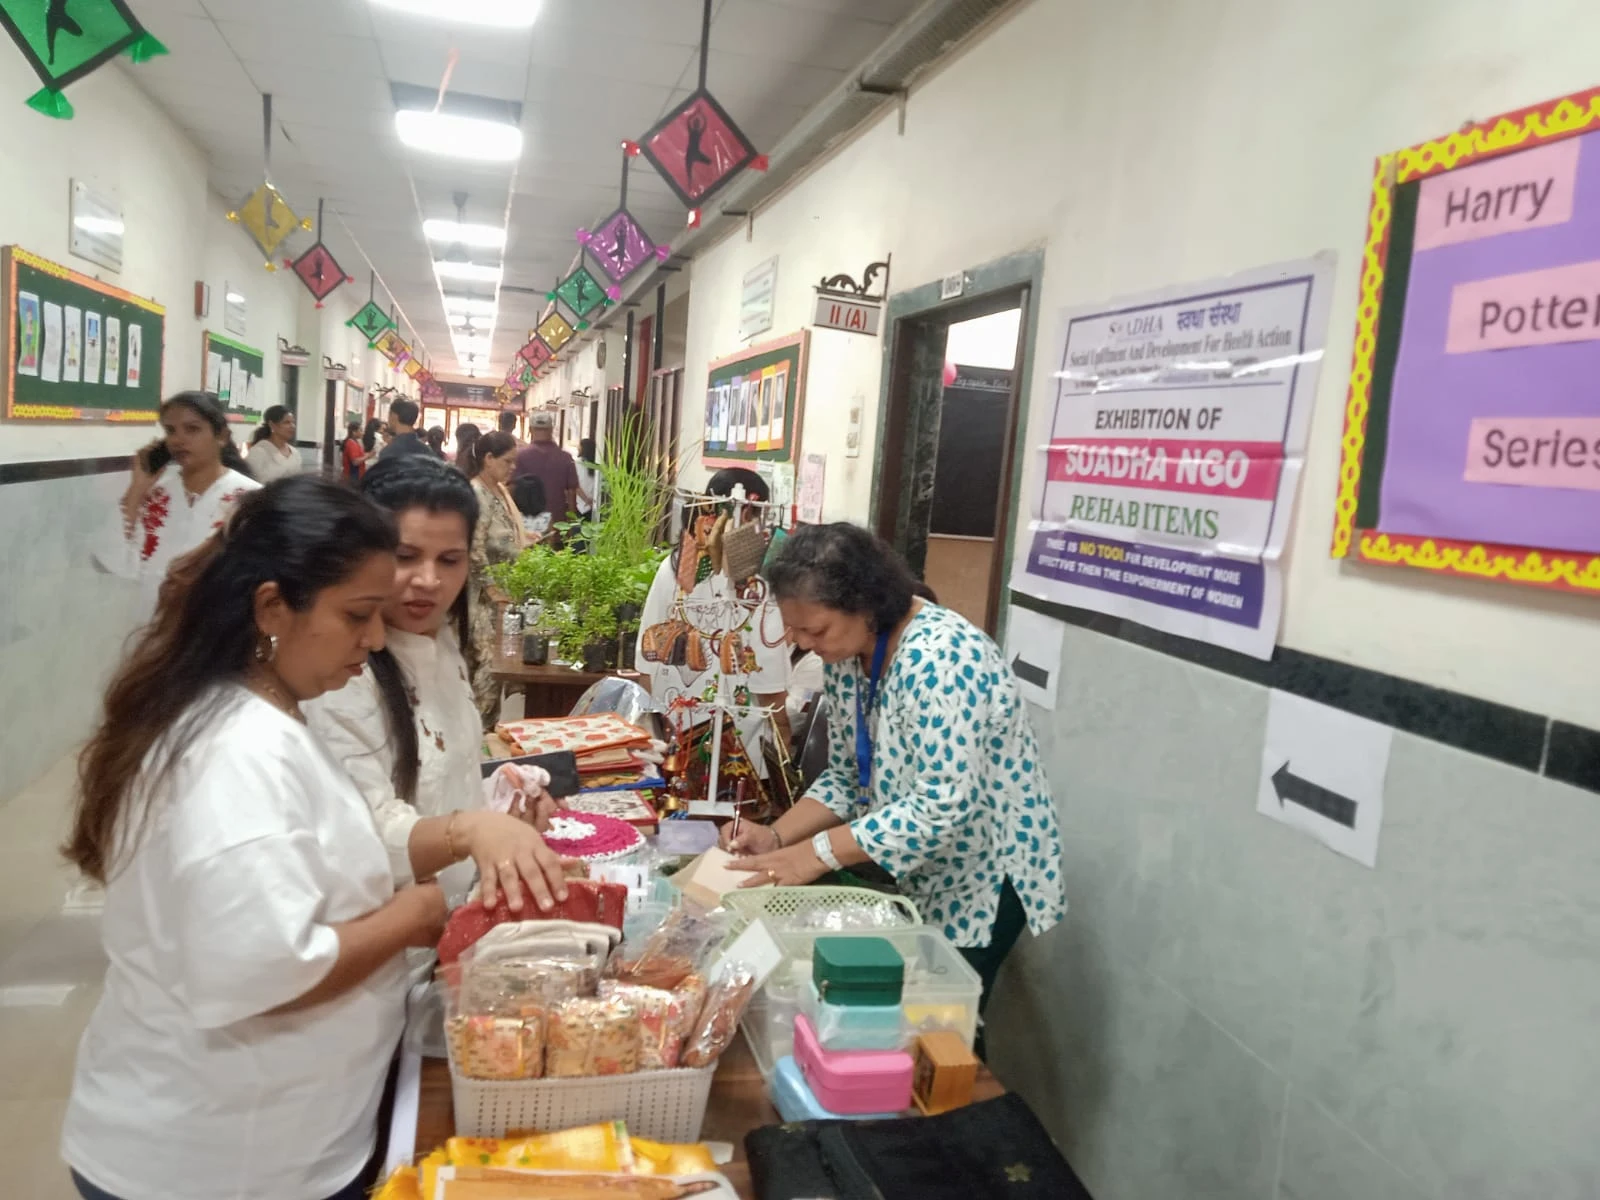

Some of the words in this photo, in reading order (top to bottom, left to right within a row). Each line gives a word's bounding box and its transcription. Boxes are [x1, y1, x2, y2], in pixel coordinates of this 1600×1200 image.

[1444, 177, 1555, 228] Harry
[845, 308, 868, 331] (A)
[1095, 408, 1191, 430] EXHIBITION
[1196, 408, 1222, 430] OF
[1064, 444, 1167, 482] SUADHA
[1176, 447, 1250, 489] NGO
[1079, 541, 1097, 557] NO
